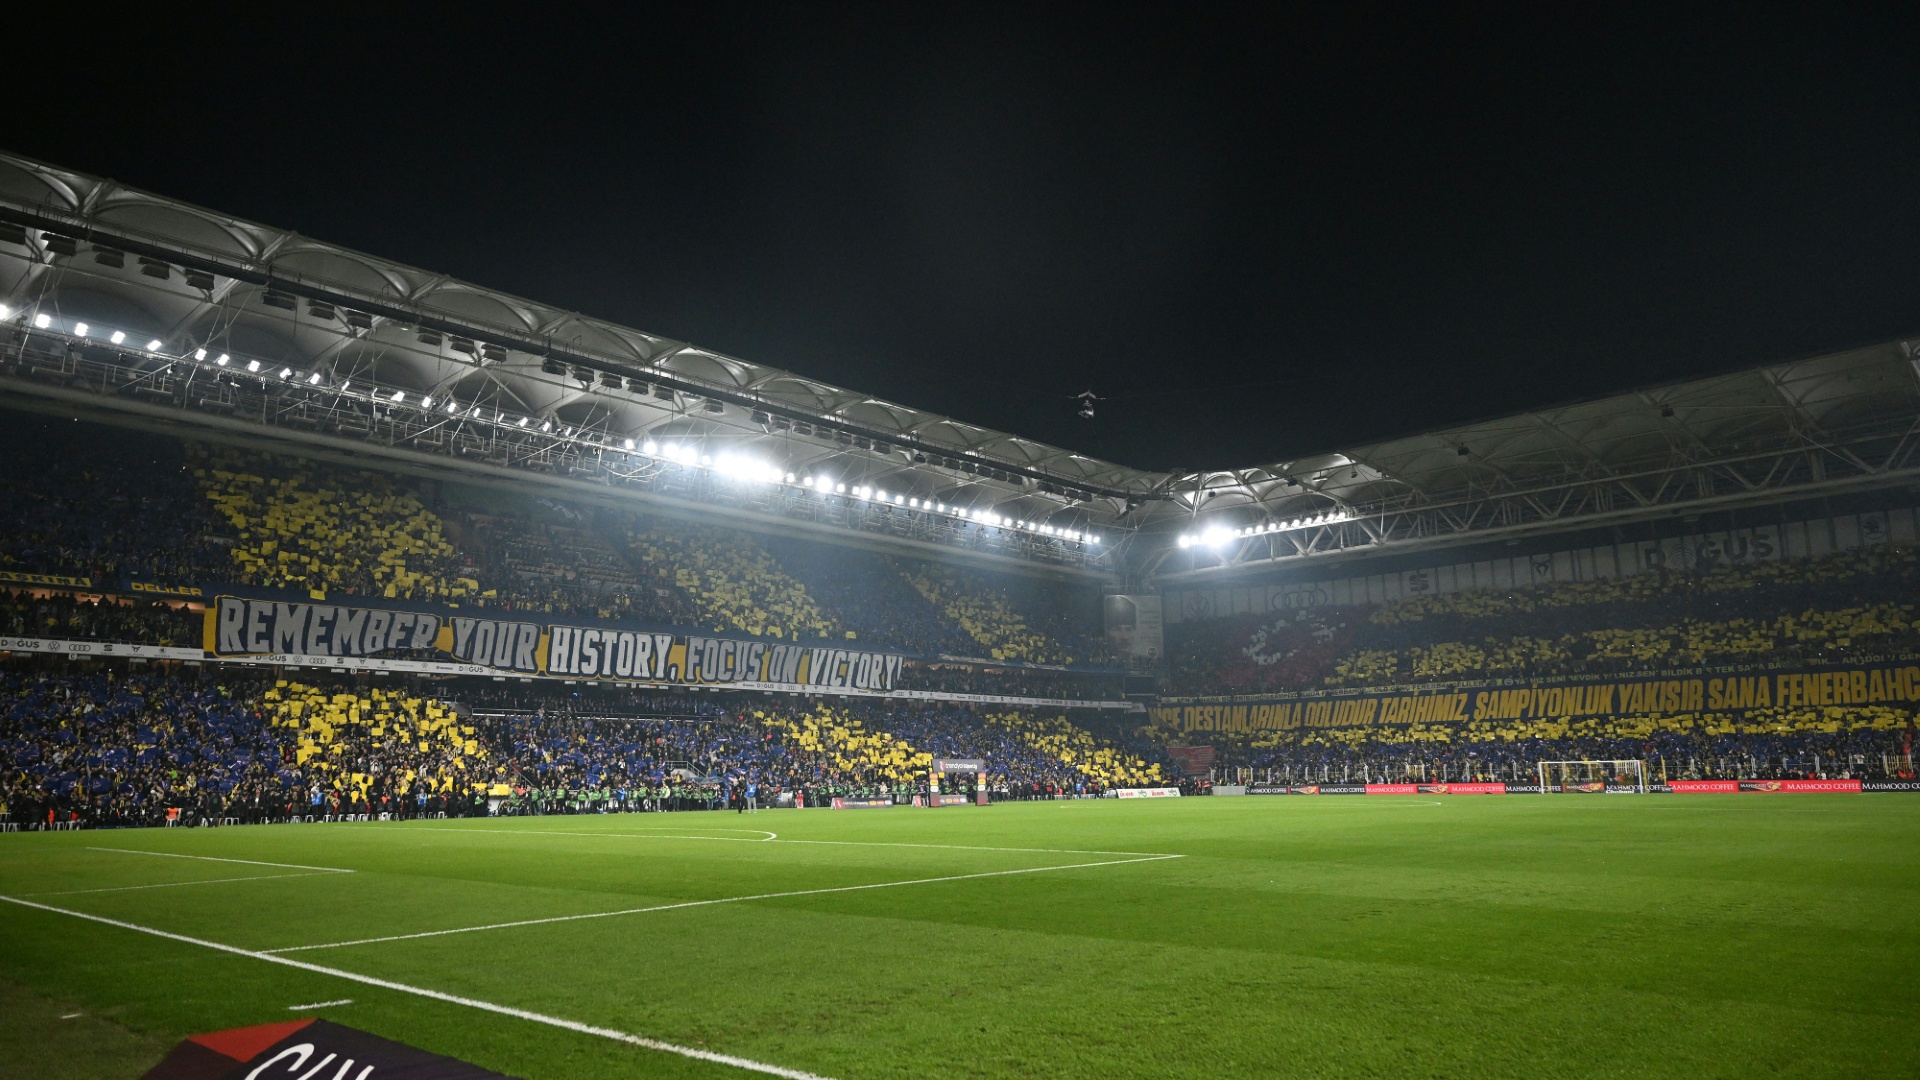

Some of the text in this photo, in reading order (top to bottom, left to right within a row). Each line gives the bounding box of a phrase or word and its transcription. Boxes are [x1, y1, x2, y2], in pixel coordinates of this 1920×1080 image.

[220, 598, 437, 655] REMEMBER
[455, 618, 675, 681] YOUR HISTORY,
[687, 637, 765, 682] FOCUS
[768, 646, 804, 683] ON
[1661, 667, 1693, 677] BİLDİK
[1715, 664, 1734, 673] TEK
[1184, 702, 1302, 733] DESTANLARINLA
[1304, 698, 1378, 728] DOLUDUR
[1473, 683, 1613, 723] ŞAMPİYONLUK
[1618, 679, 1704, 715] YAKIŞIR
[1708, 675, 1771, 709] SANA
[1788, 783, 1831, 791] MAHMOOD
[1863, 783, 1910, 791] MAHMOOD
